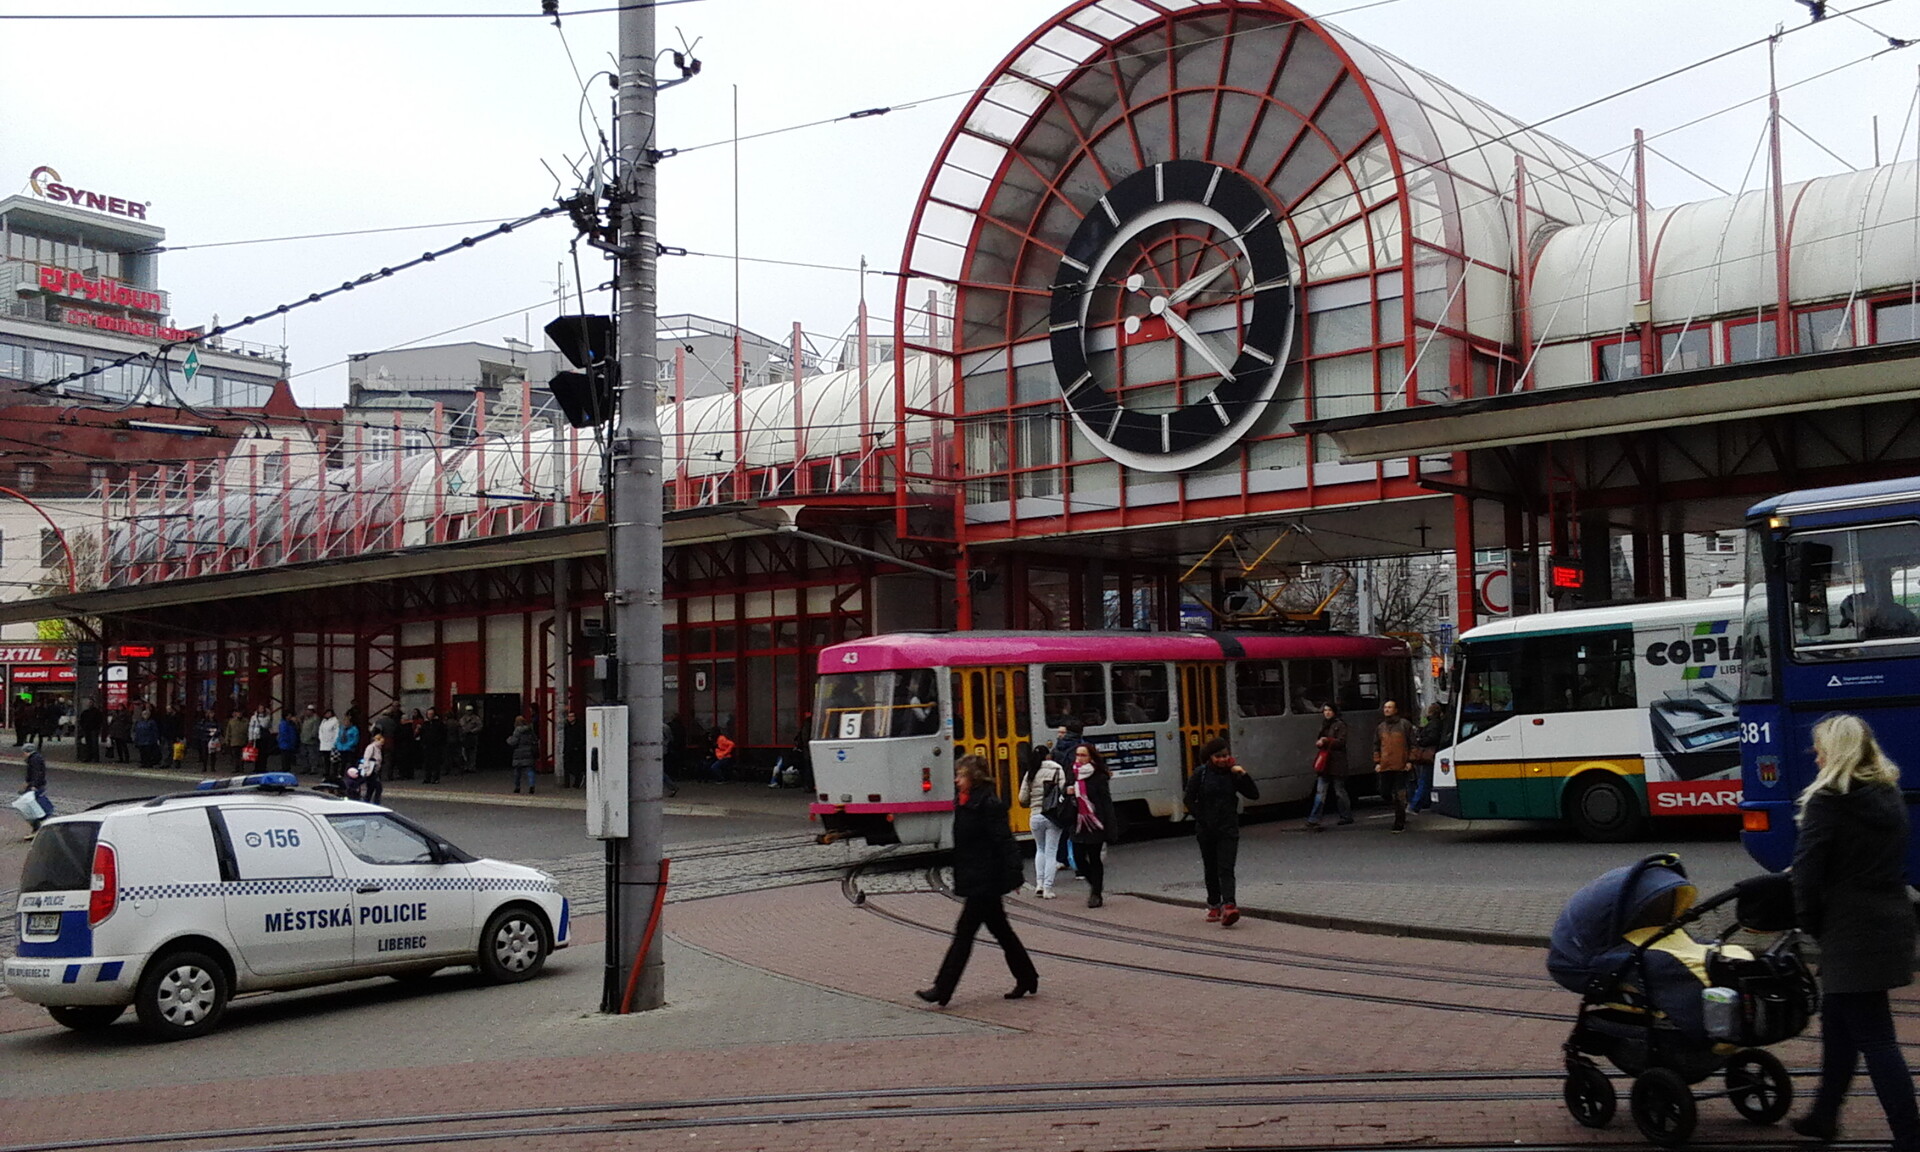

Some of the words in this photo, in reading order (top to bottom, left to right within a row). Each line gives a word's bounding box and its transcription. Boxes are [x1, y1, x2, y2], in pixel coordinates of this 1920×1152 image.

[46, 183, 146, 220] SYNER
[68, 271, 161, 311] Pytloun
[842, 652, 858, 664] 43
[846, 718, 856, 735] 5
[1741, 722, 1770, 744] 381
[264, 828, 301, 848] 156
[265, 903, 352, 933] MĚSTSKÁ
[360, 902, 427, 925] POLICIE
[378, 936, 427, 952] LIBEREC
